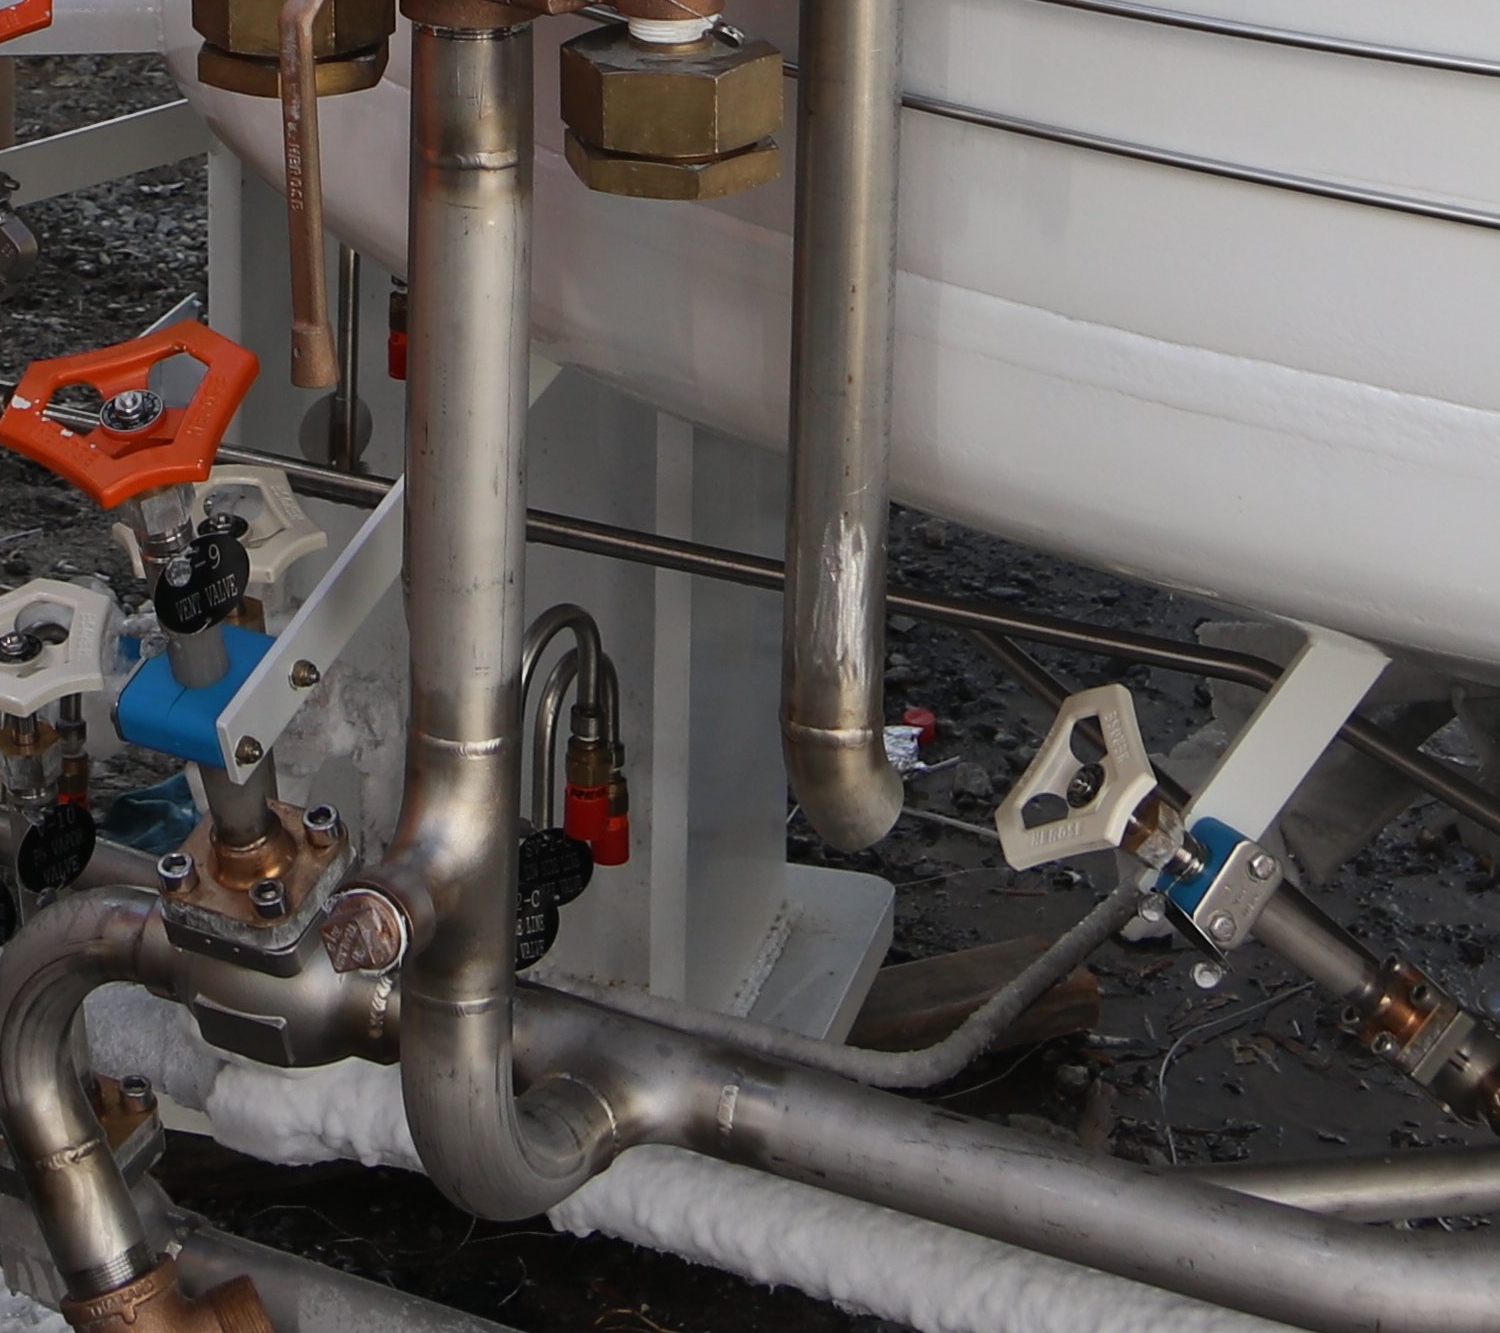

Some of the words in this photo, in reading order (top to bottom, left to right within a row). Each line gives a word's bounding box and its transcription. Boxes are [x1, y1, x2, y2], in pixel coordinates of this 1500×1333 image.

[194, 543, 221, 569] -9
[175, 592, 202, 622] VENT
[204, 573, 239, 608] VALVE
